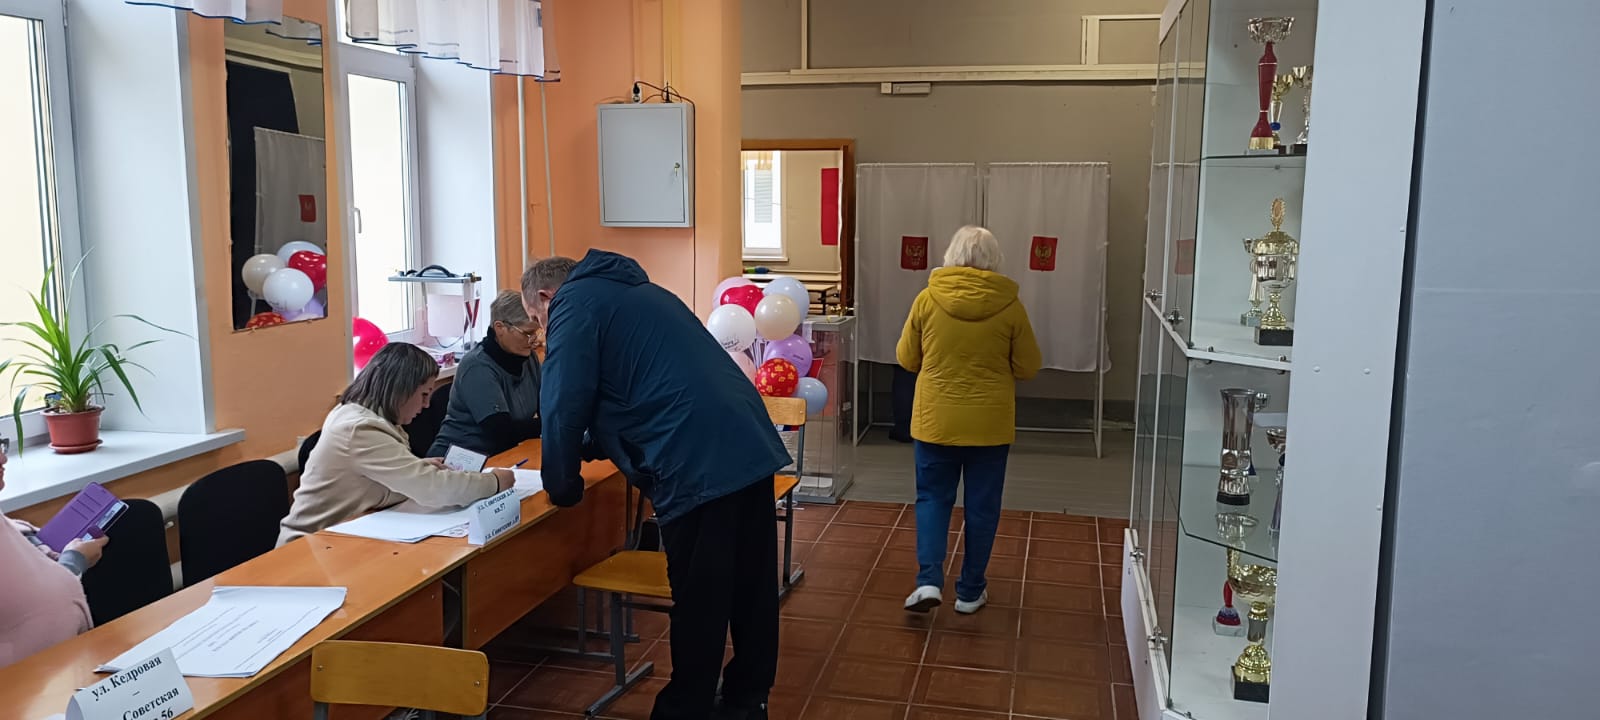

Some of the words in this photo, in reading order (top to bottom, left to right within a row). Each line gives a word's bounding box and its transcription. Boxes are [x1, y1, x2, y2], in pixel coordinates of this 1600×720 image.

[91, 685, 111, 702] ул.
[110, 656, 163, 689] Кедровая
[122, 687, 180, 720] Советская
